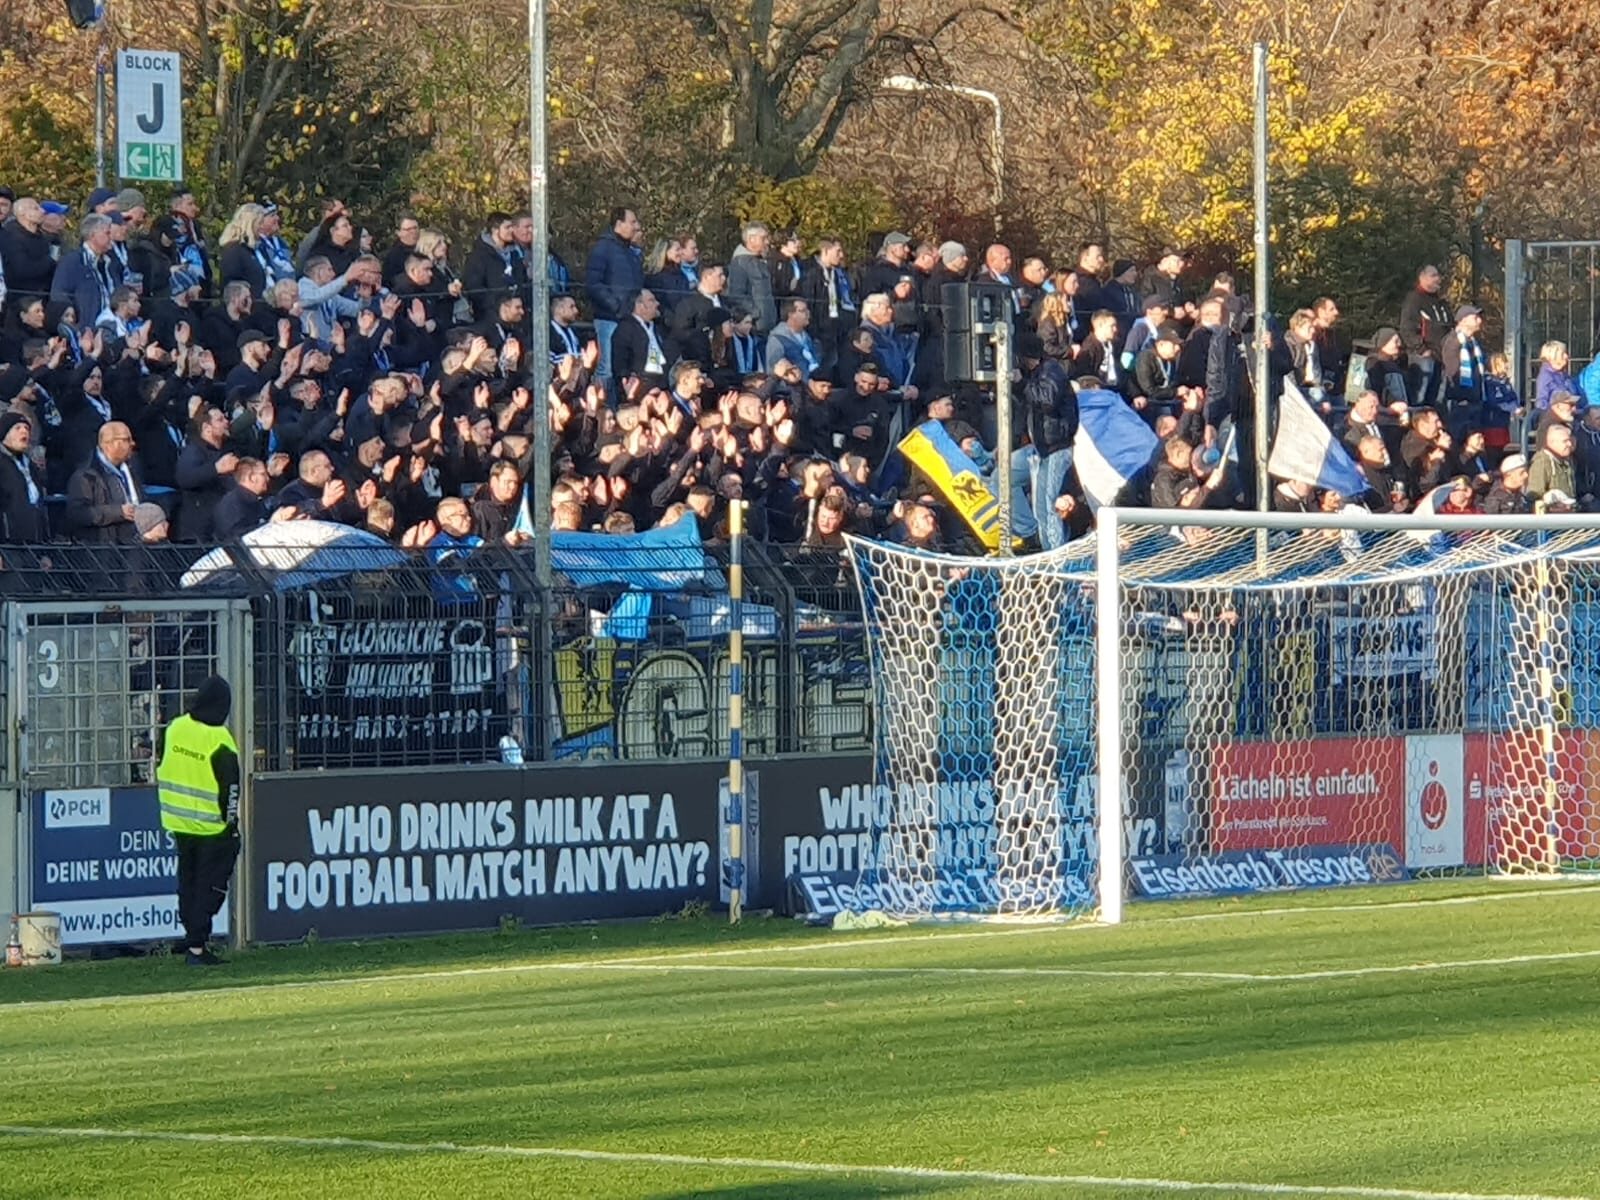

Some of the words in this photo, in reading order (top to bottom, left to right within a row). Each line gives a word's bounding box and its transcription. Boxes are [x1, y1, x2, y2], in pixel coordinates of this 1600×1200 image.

[125, 55, 172, 71] BLOCK
[136, 82, 164, 134] J
[339, 620, 447, 654] GLORREICHE
[38, 640, 59, 688] 3
[1220, 772, 1285, 800] Lächeln
[1289, 772, 1311, 798] ist
[1316, 767, 1381, 796] einfach.
[68, 799, 101, 816] PCH
[308, 805, 392, 855] WHO
[401, 800, 516, 852] DRINKS
[525, 796, 603, 845] MILK
[609, 794, 650, 840] AT
[655, 793, 678, 839] A
[819, 784, 891, 830] WHO
[121, 831, 160, 852] DEIN
[165, 829, 176, 851] S
[46, 857, 99, 884] DEINE
[105, 854, 179, 881] WORKW
[267, 856, 430, 910] FOOTBALL
[435, 849, 546, 901] MATCH
[553, 841, 709, 894] ANYWAY?
[1132, 852, 1271, 895] Eisenbach
[61, 904, 182, 936] ww.pch-shop
